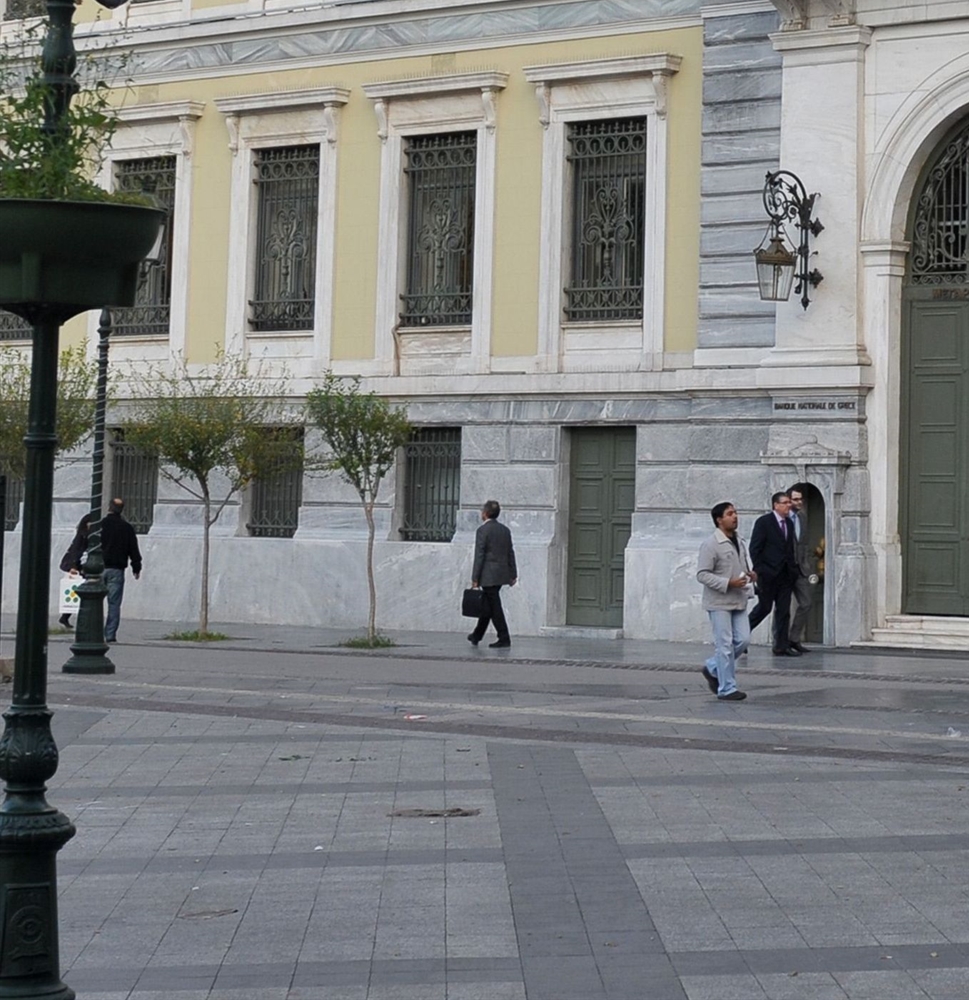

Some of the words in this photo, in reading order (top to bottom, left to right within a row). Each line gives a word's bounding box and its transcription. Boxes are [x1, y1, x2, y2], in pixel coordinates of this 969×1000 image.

[774, 402, 796, 410] BANQUE
[798, 402, 826, 410] NATIONALE
[828, 402, 836, 410] DE
